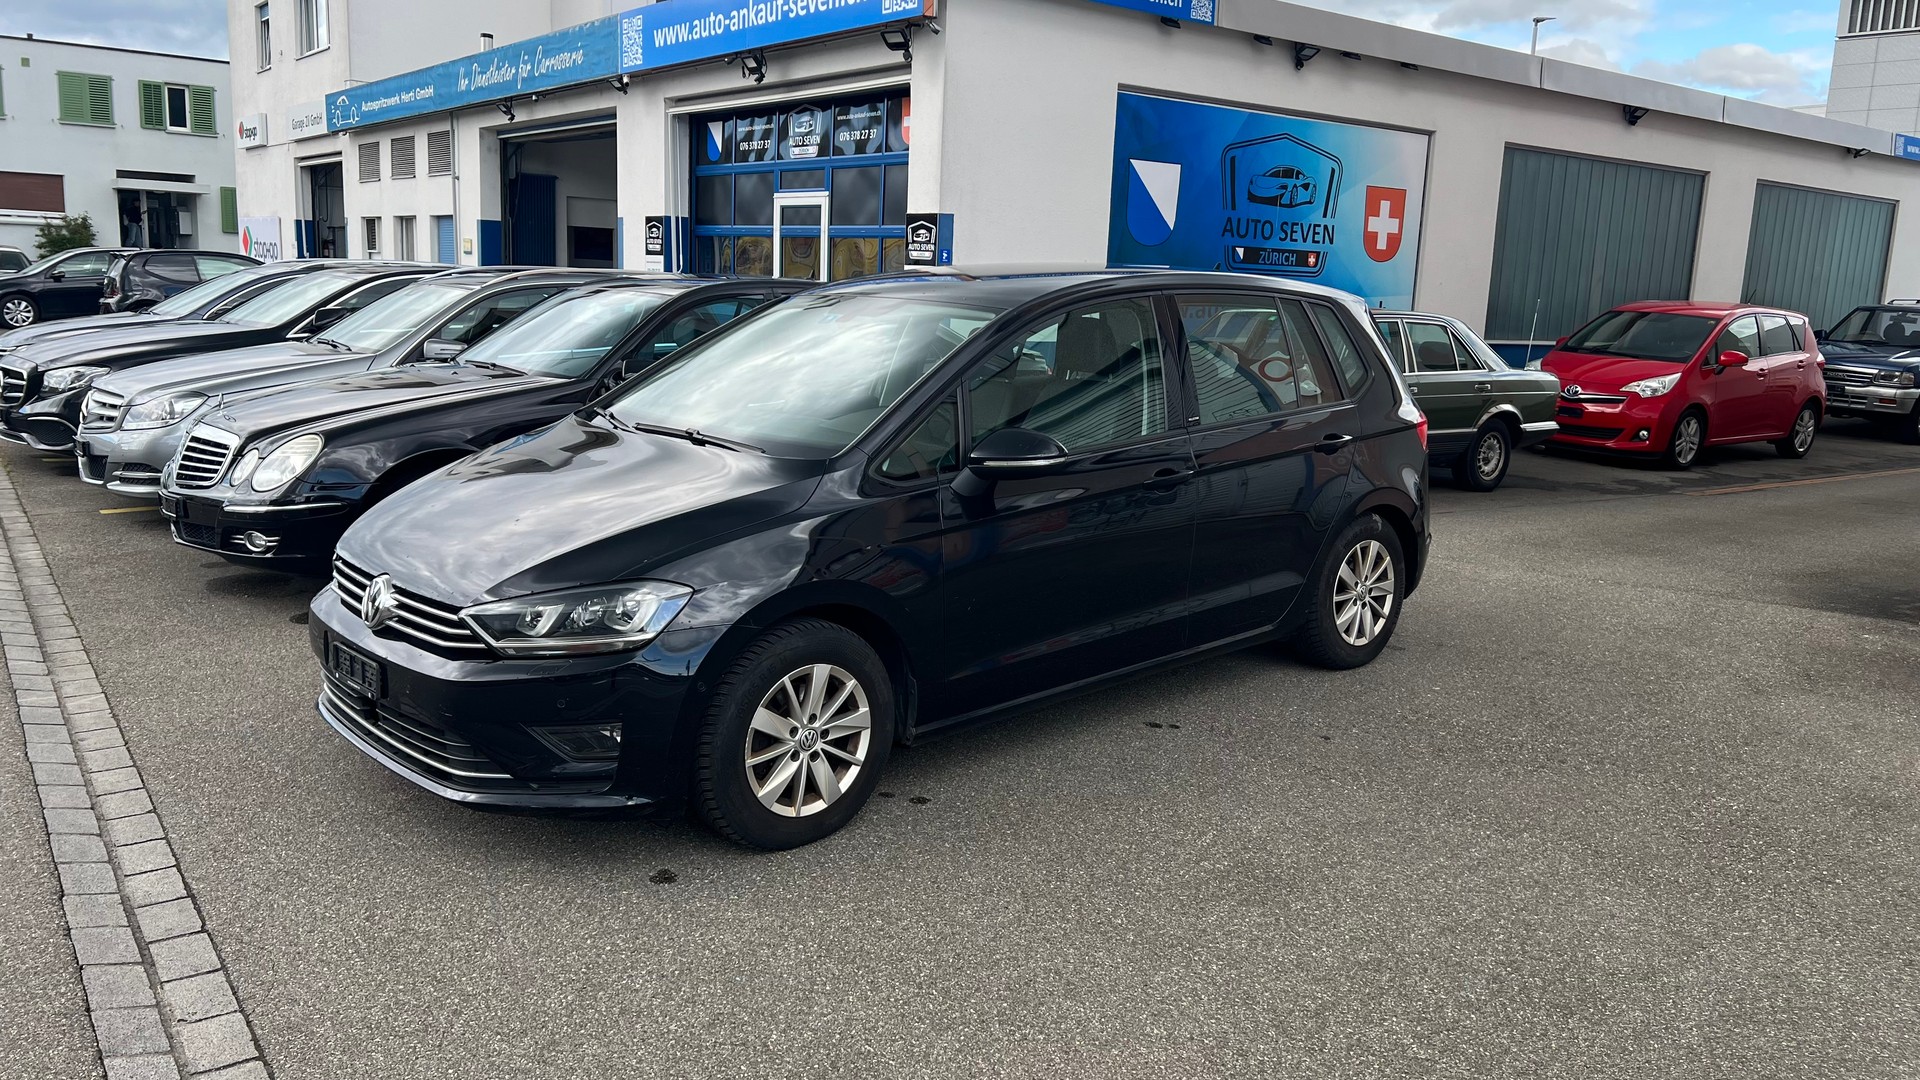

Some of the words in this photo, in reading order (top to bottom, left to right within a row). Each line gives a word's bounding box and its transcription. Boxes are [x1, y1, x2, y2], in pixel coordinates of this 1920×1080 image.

[458, 66, 469, 92] Ihr
[470, 57, 516, 91] Dienstleister
[517, 50, 532, 89] für
[534, 42, 584, 77] Carrosserie
[361, 93, 401, 112] Autospritzwerk
[415, 84, 434, 100] GmbH
[788, 136, 803, 146] AUTO
[803, 135, 820, 145] SEVEN
[840, 132, 850, 141] 076
[850, 131, 860, 140] 378
[861, 130, 869, 139] 27
[869, 129, 877, 138] 37
[1221, 216, 1274, 240] AUTO
[1278, 220, 1335, 245] SEVEN
[908, 243, 921, 251] AUTO
[920, 243, 935, 251] SEVEN
[1258, 249, 1297, 266] ZÜRICH
